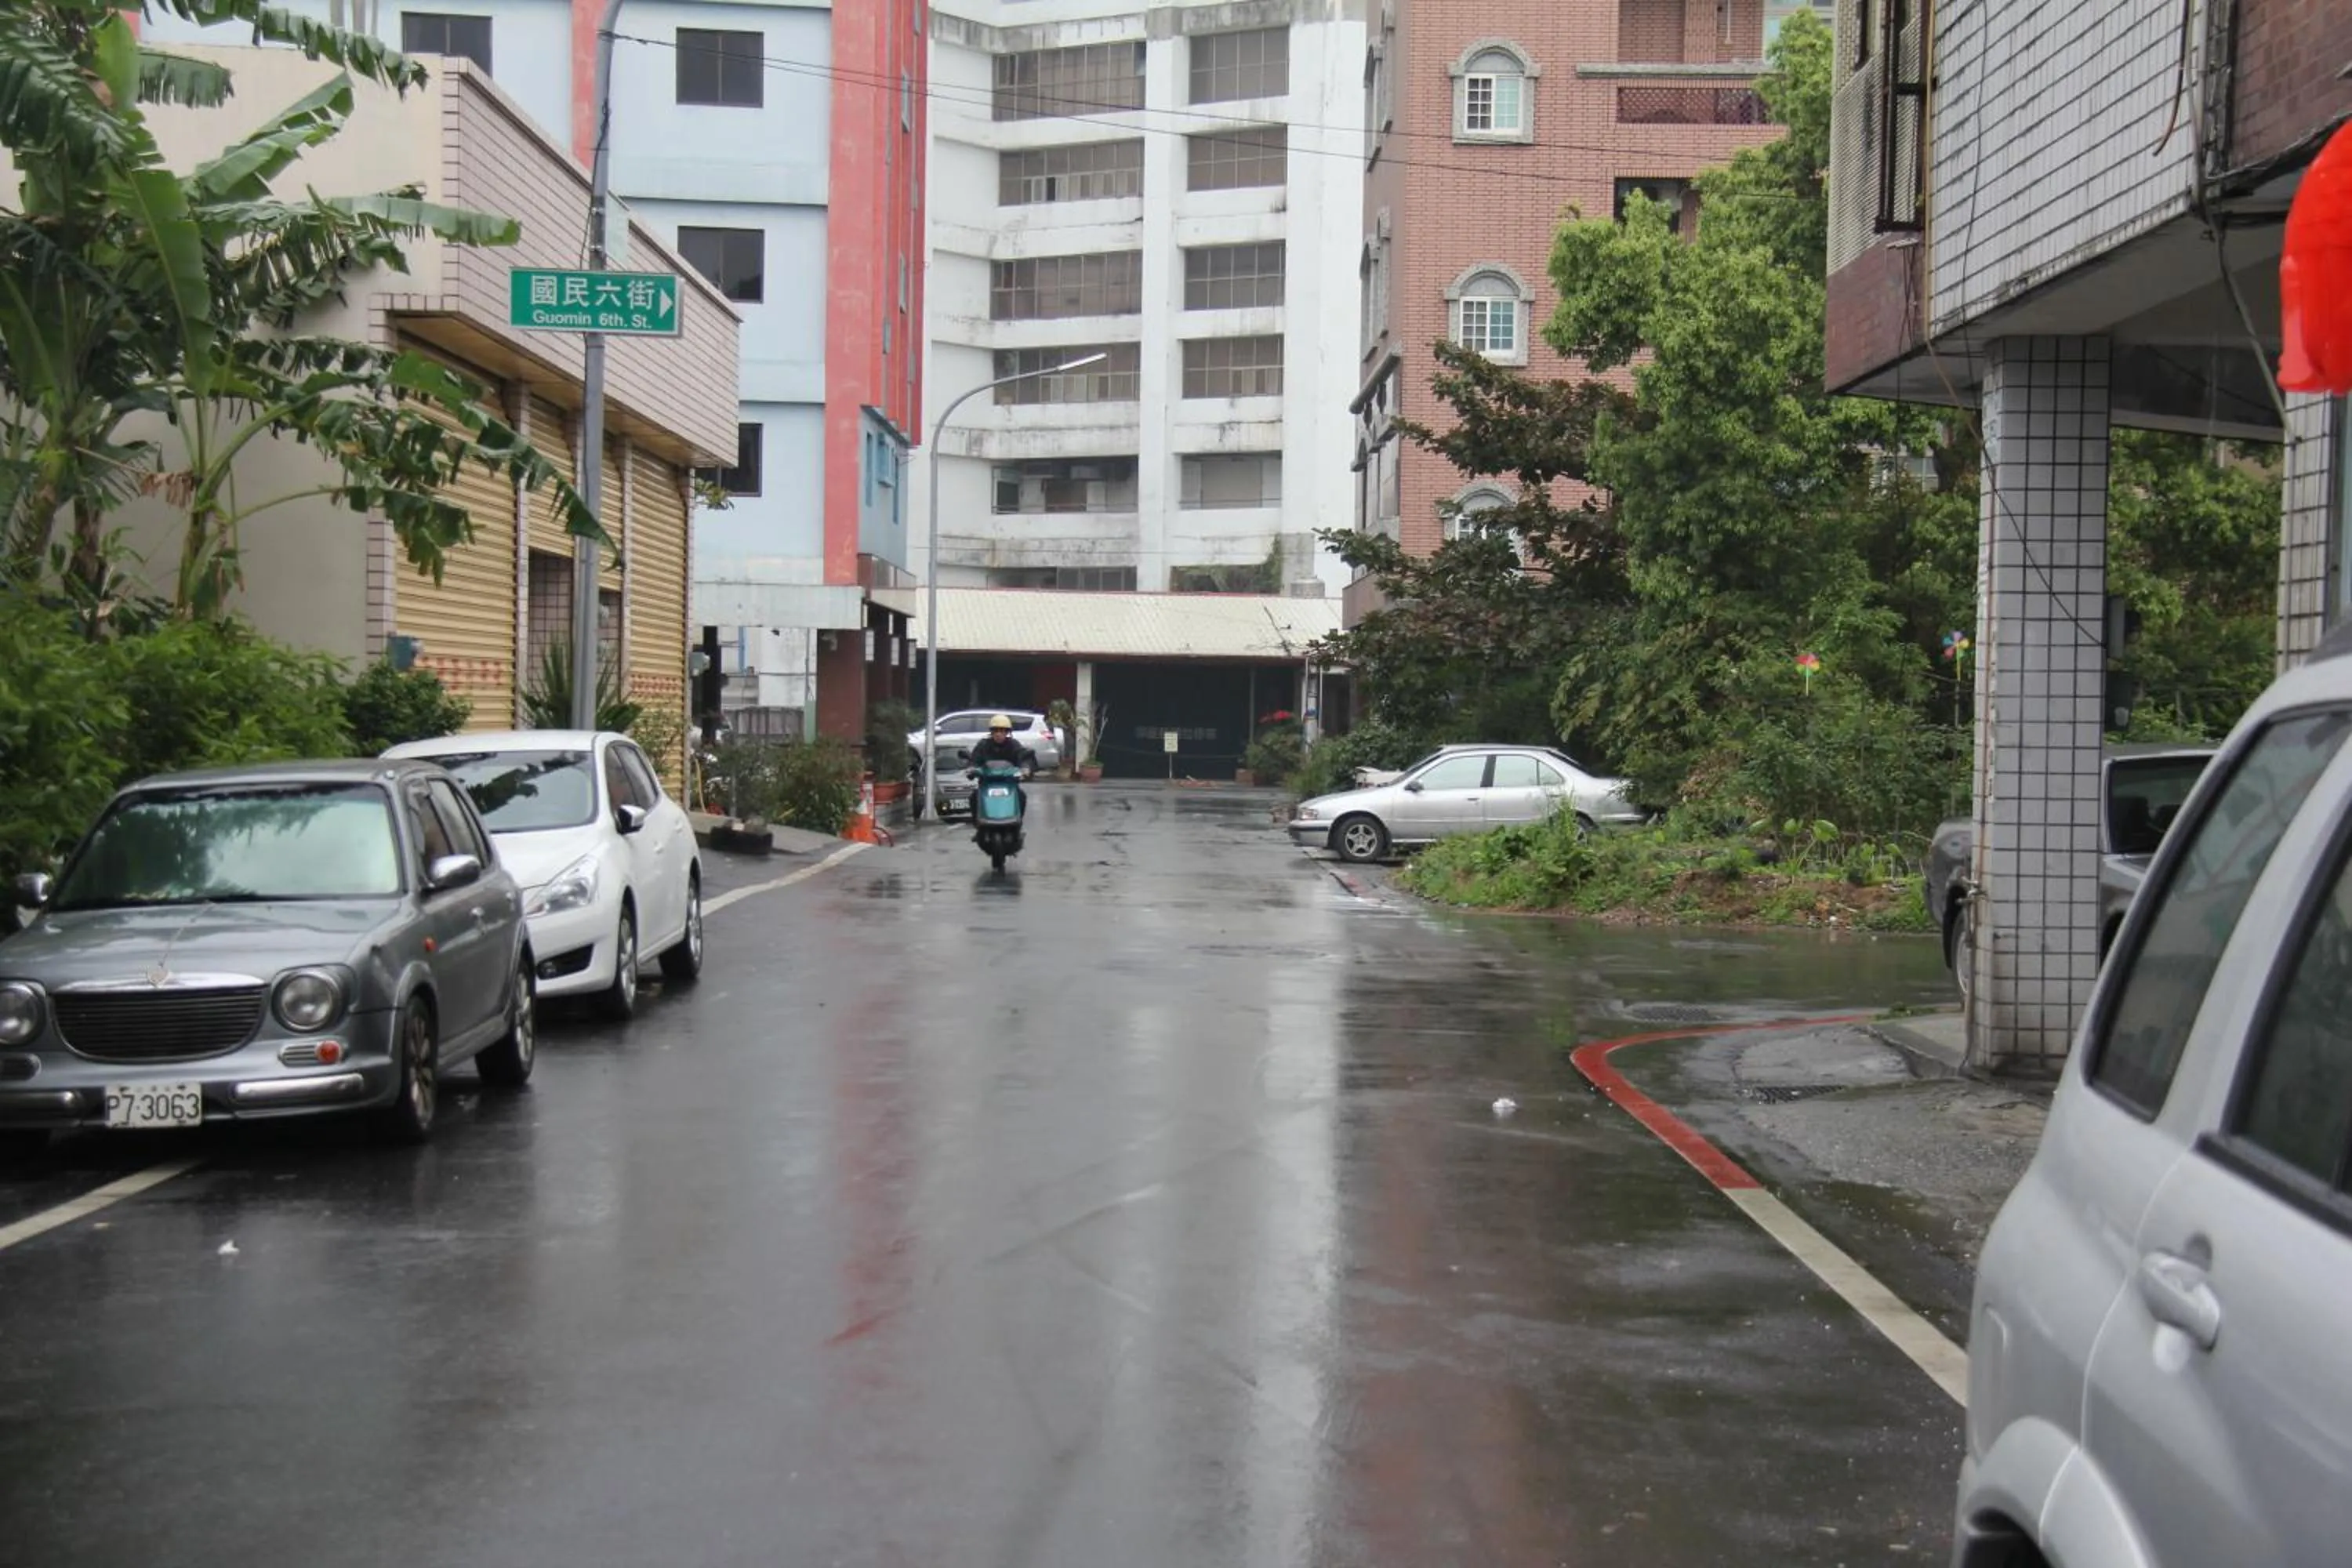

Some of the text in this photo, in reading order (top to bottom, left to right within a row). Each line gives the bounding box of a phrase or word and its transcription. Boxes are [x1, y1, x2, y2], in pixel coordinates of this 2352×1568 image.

[531, 274, 655, 310] 國民六街
[532, 310, 652, 329] Guomin 6th. St.
